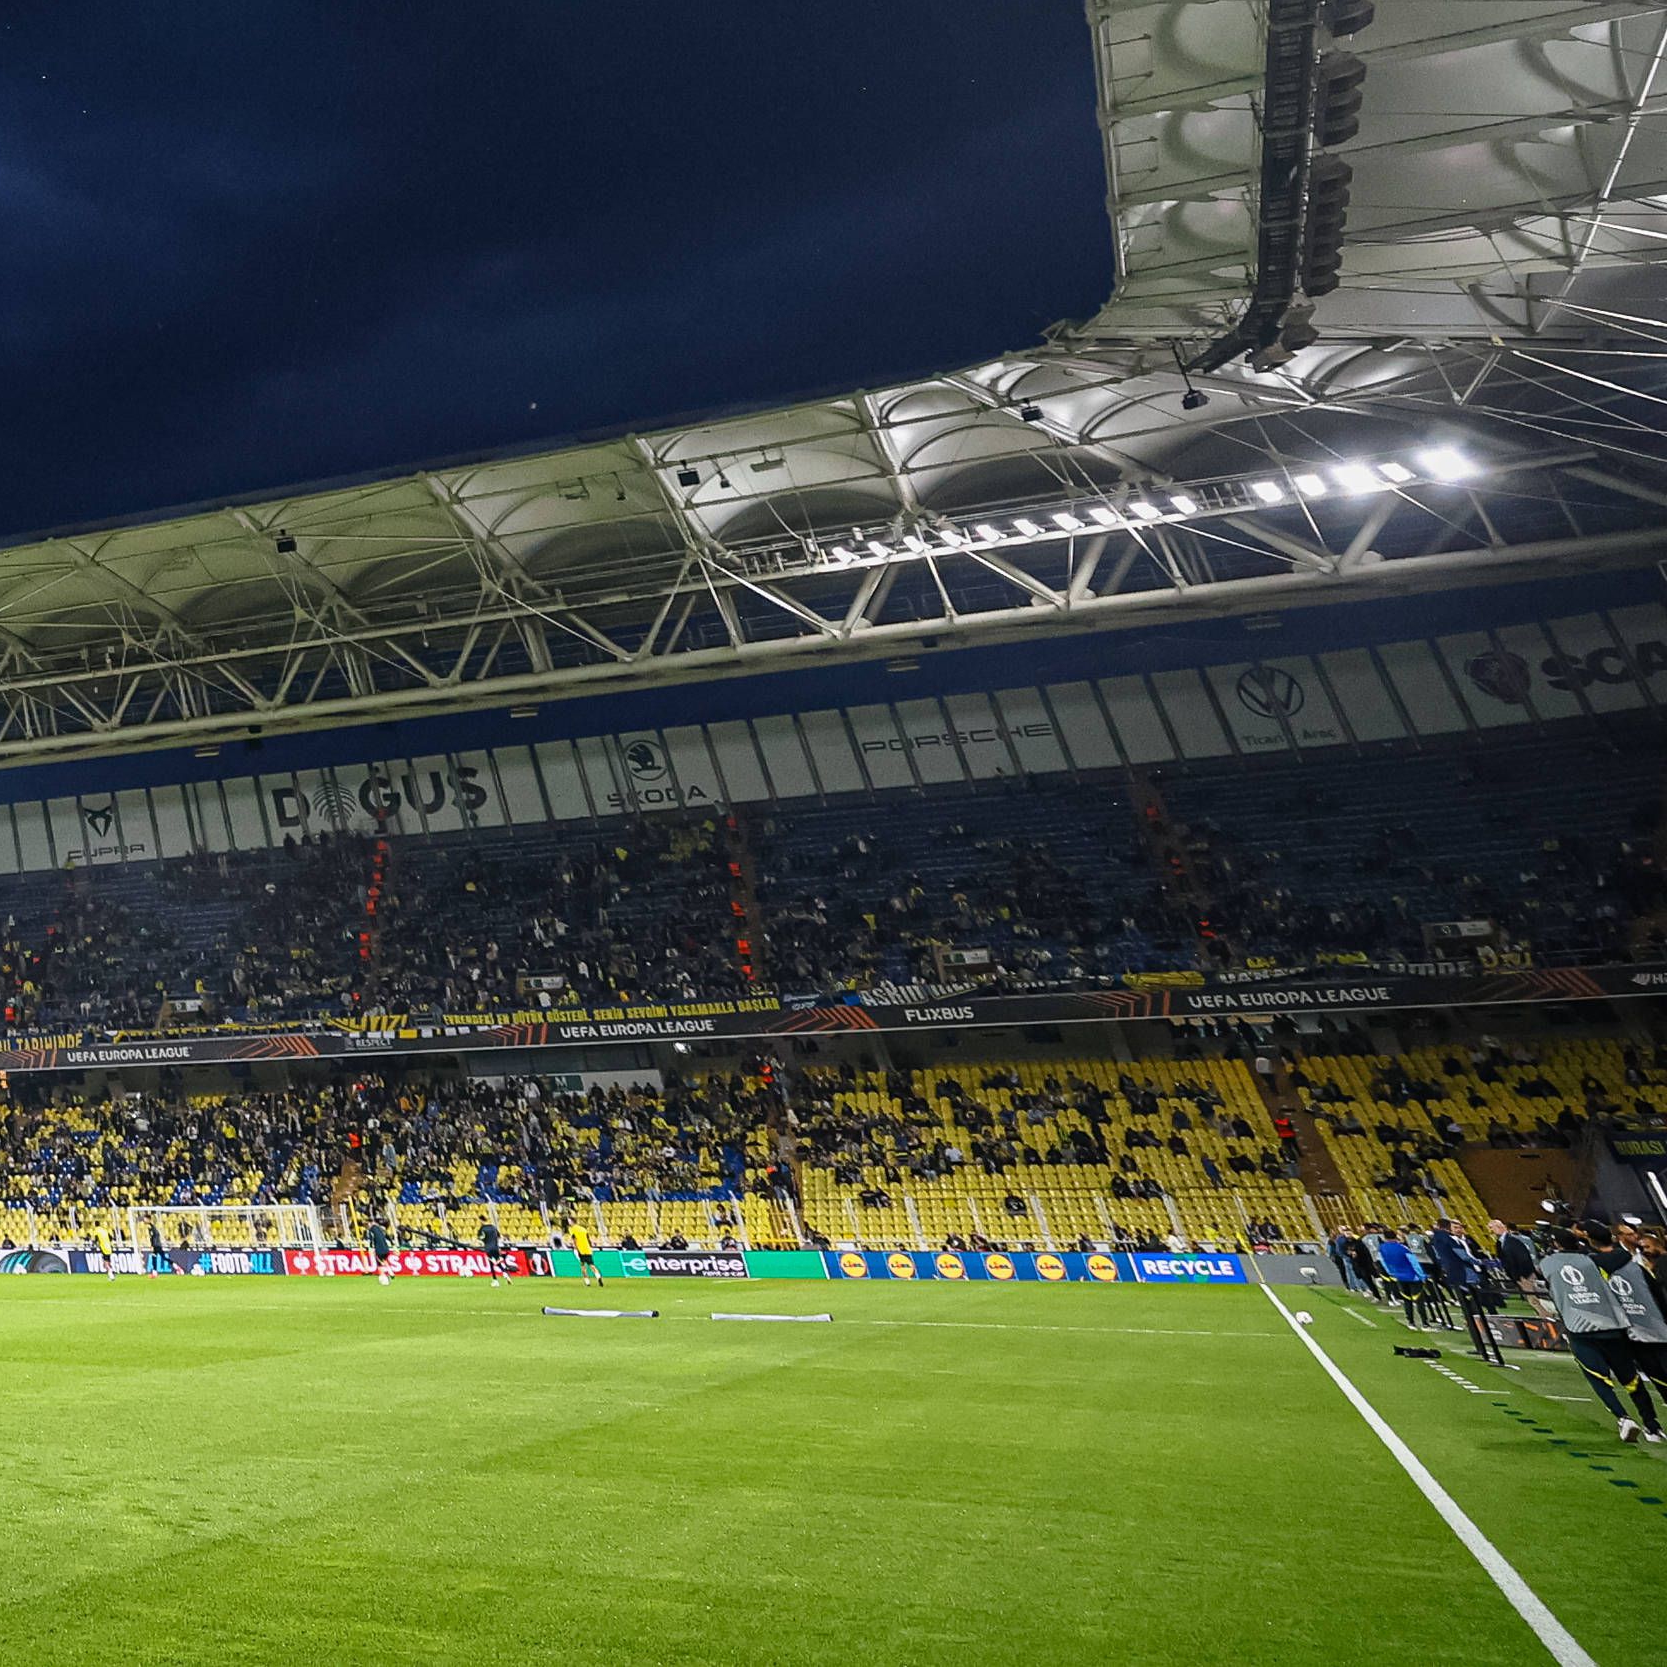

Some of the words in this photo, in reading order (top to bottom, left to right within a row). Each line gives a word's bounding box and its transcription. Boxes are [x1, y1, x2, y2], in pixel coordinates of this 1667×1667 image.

[861, 722, 1053, 754] PORSCHE
[1189, 993, 1236, 1008] UEFA
[1238, 990, 1313, 1007] EUROPA
[1318, 987, 1390, 1004] LEAGUE
[560, 1025, 598, 1038] UEFA
[599, 1022, 656, 1037] EUROPA
[657, 1019, 715, 1034] LEAGUE
[356, 1037, 392, 1047] RESPECT
[67, 1051, 97, 1063] UEFA
[99, 1049, 144, 1062] EUROPA
[146, 1047, 190, 1059] LEAGUE
[85, 1253, 143, 1274] WECOM
[198, 1253, 274, 1273] #FOOTBALL
[315, 1254, 402, 1273] STRAUS
[426, 1255, 517, 1273] STRAUS
[622, 1255, 744, 1274] enterprise
[1142, 1259, 1235, 1277] RECYCLE
